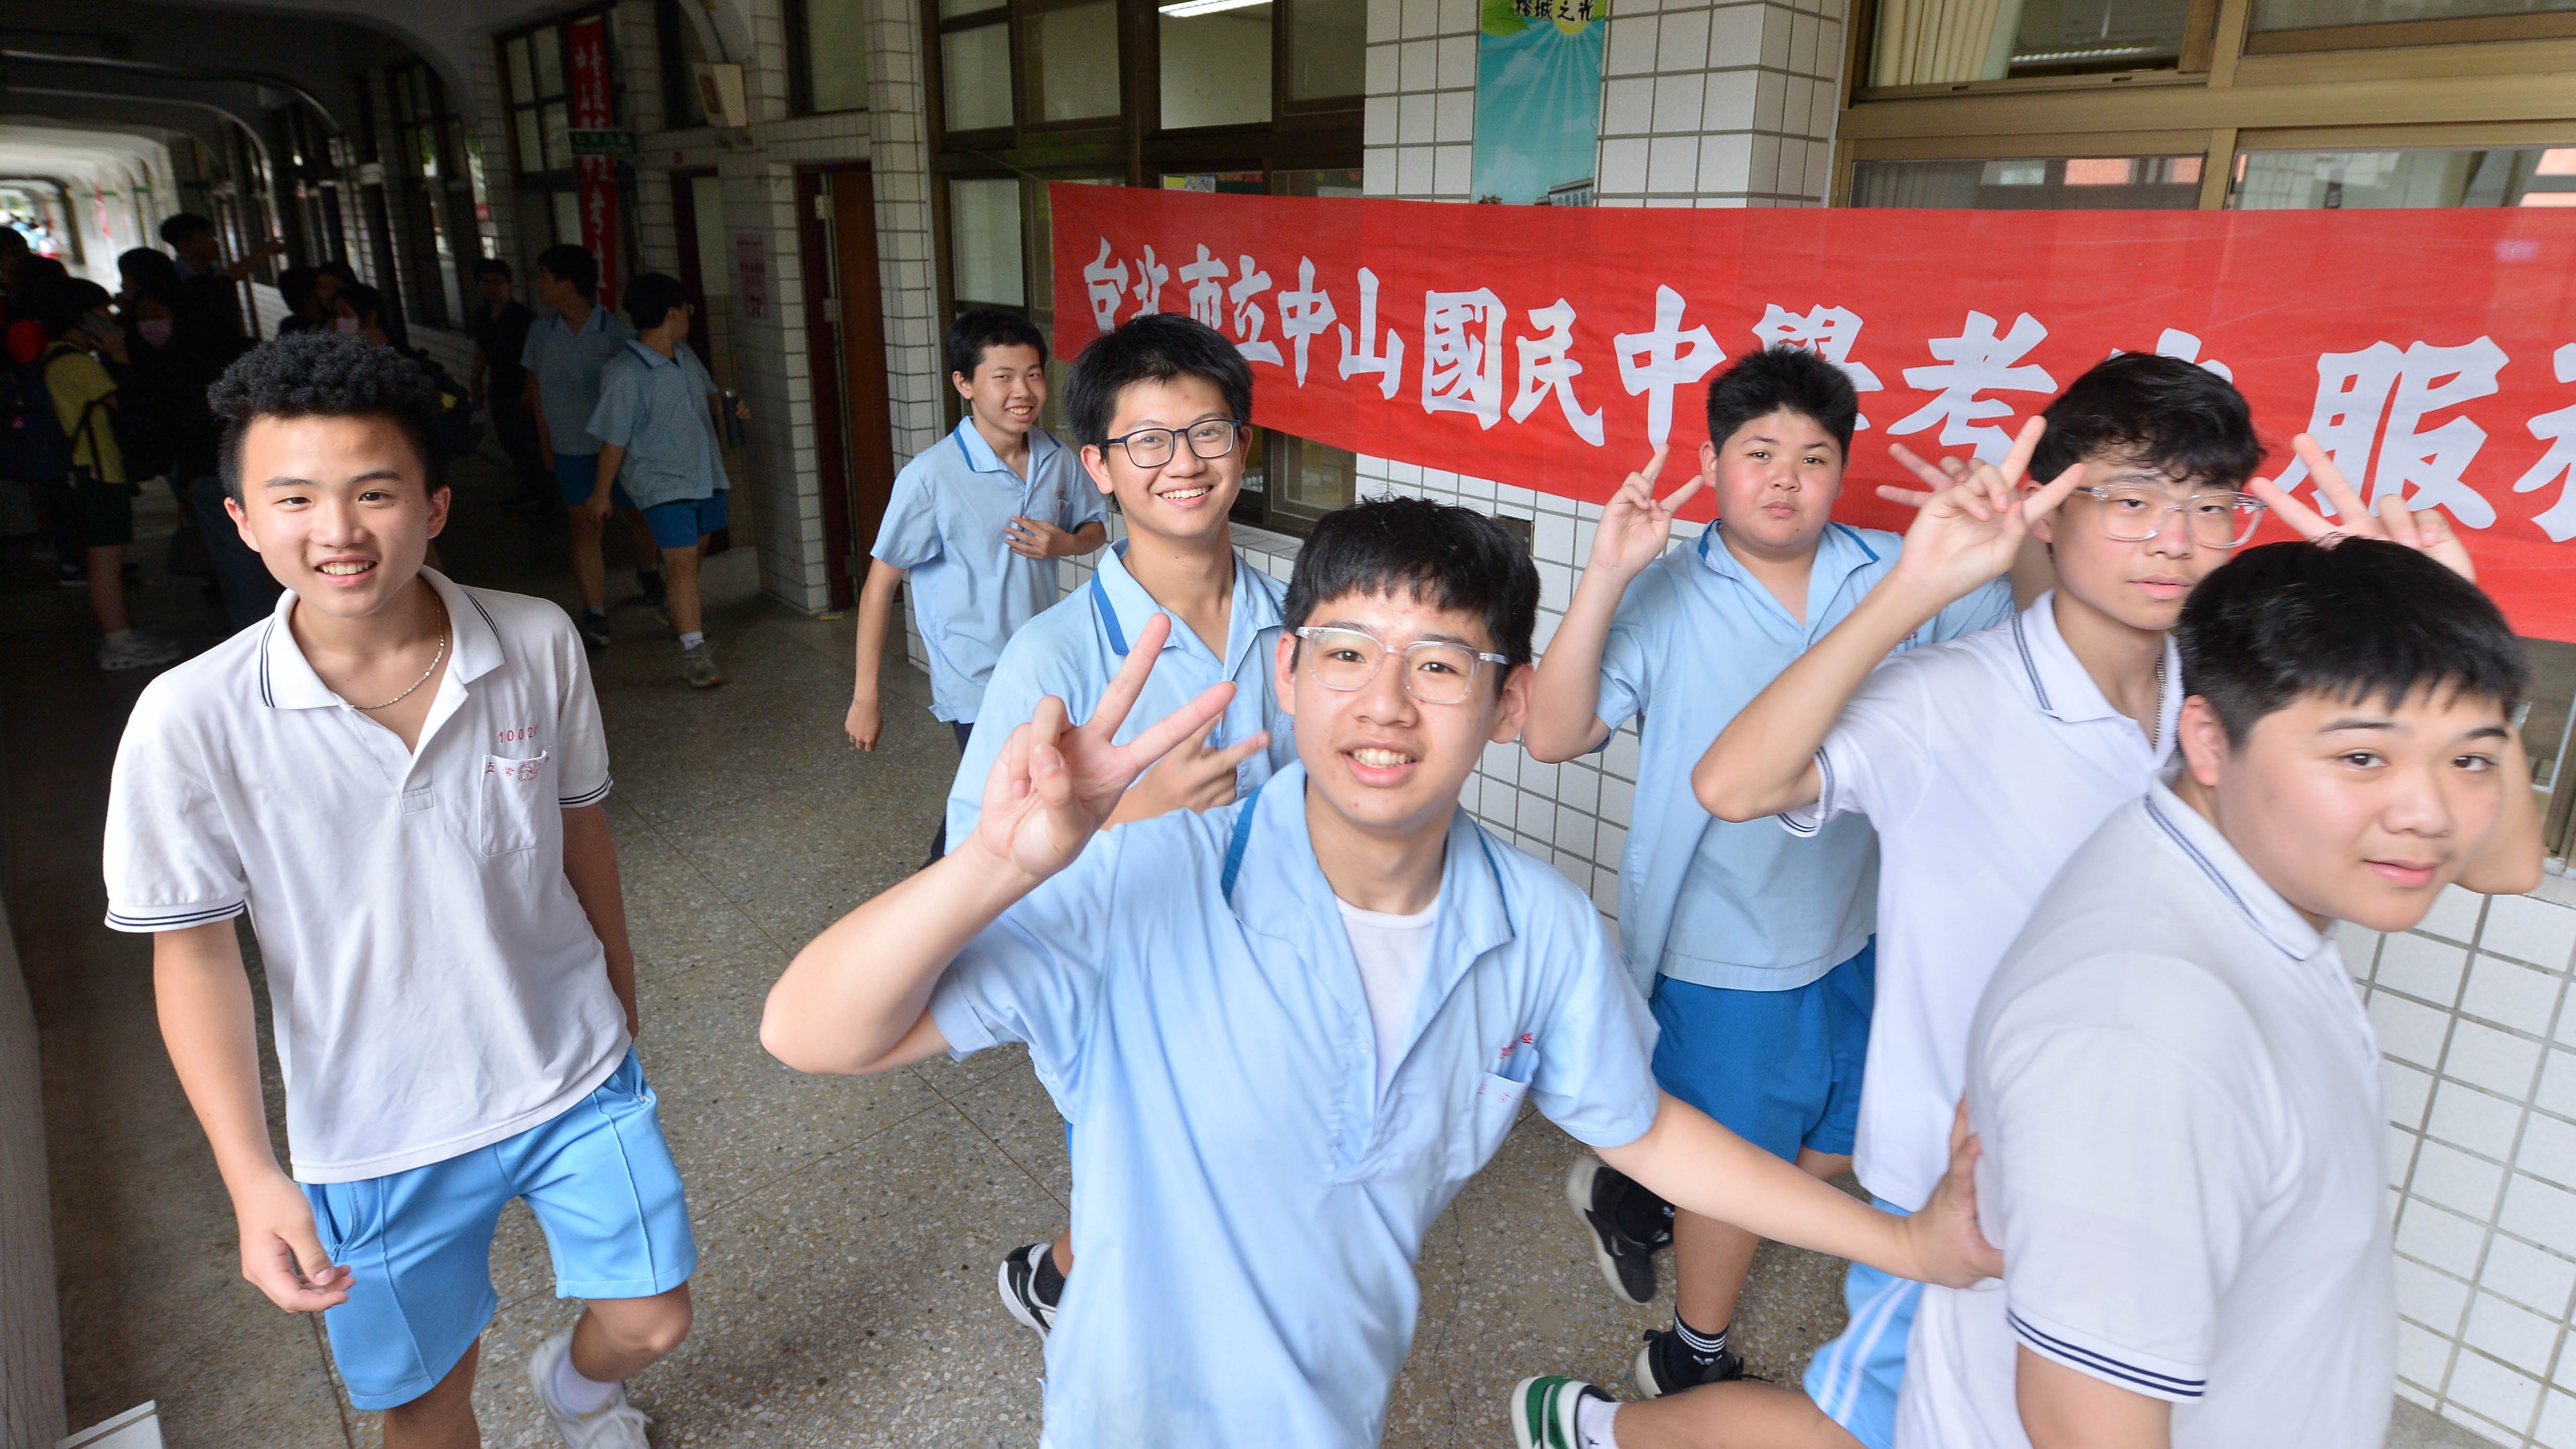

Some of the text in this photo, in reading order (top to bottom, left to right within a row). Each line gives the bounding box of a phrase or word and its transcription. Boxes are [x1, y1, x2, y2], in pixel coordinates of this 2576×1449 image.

[1084, 235, 2576, 543] 台北市立中山國民中學考服
